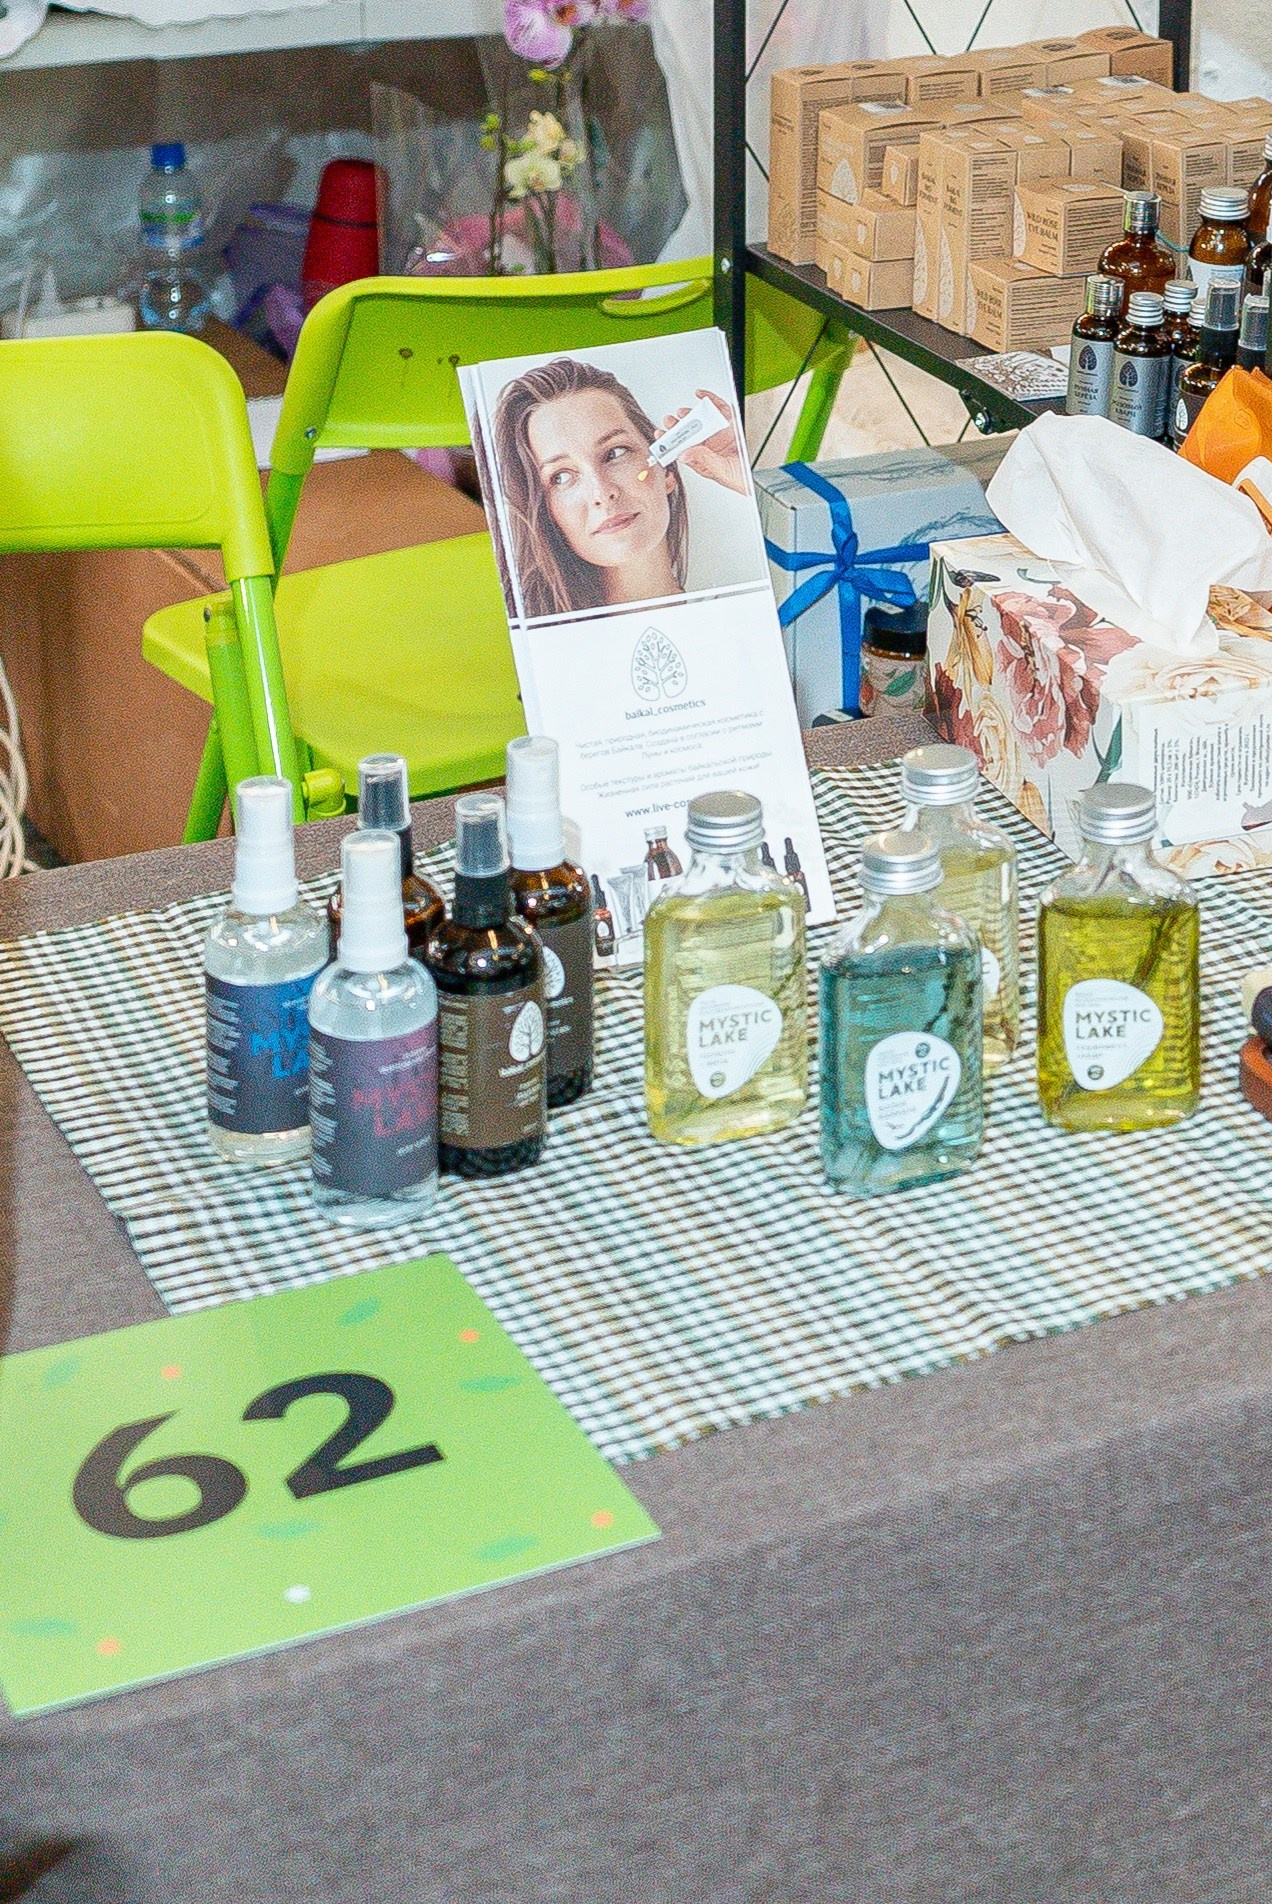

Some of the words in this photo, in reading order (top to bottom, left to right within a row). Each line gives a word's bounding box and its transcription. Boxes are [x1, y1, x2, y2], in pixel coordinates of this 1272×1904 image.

[624, 699, 706, 721] baikal_cosmetics
[699, 1009, 772, 1032] MYSTIC
[1075, 1009, 1151, 1025] MYSTIC
[699, 1027, 747, 1048] LAKE
[1075, 1024, 1126, 1040] LAKE
[878, 1056, 950, 1084] MYSTIC
[878, 1077, 927, 1100] LAKE
[72, 1371, 445, 1540] 62
